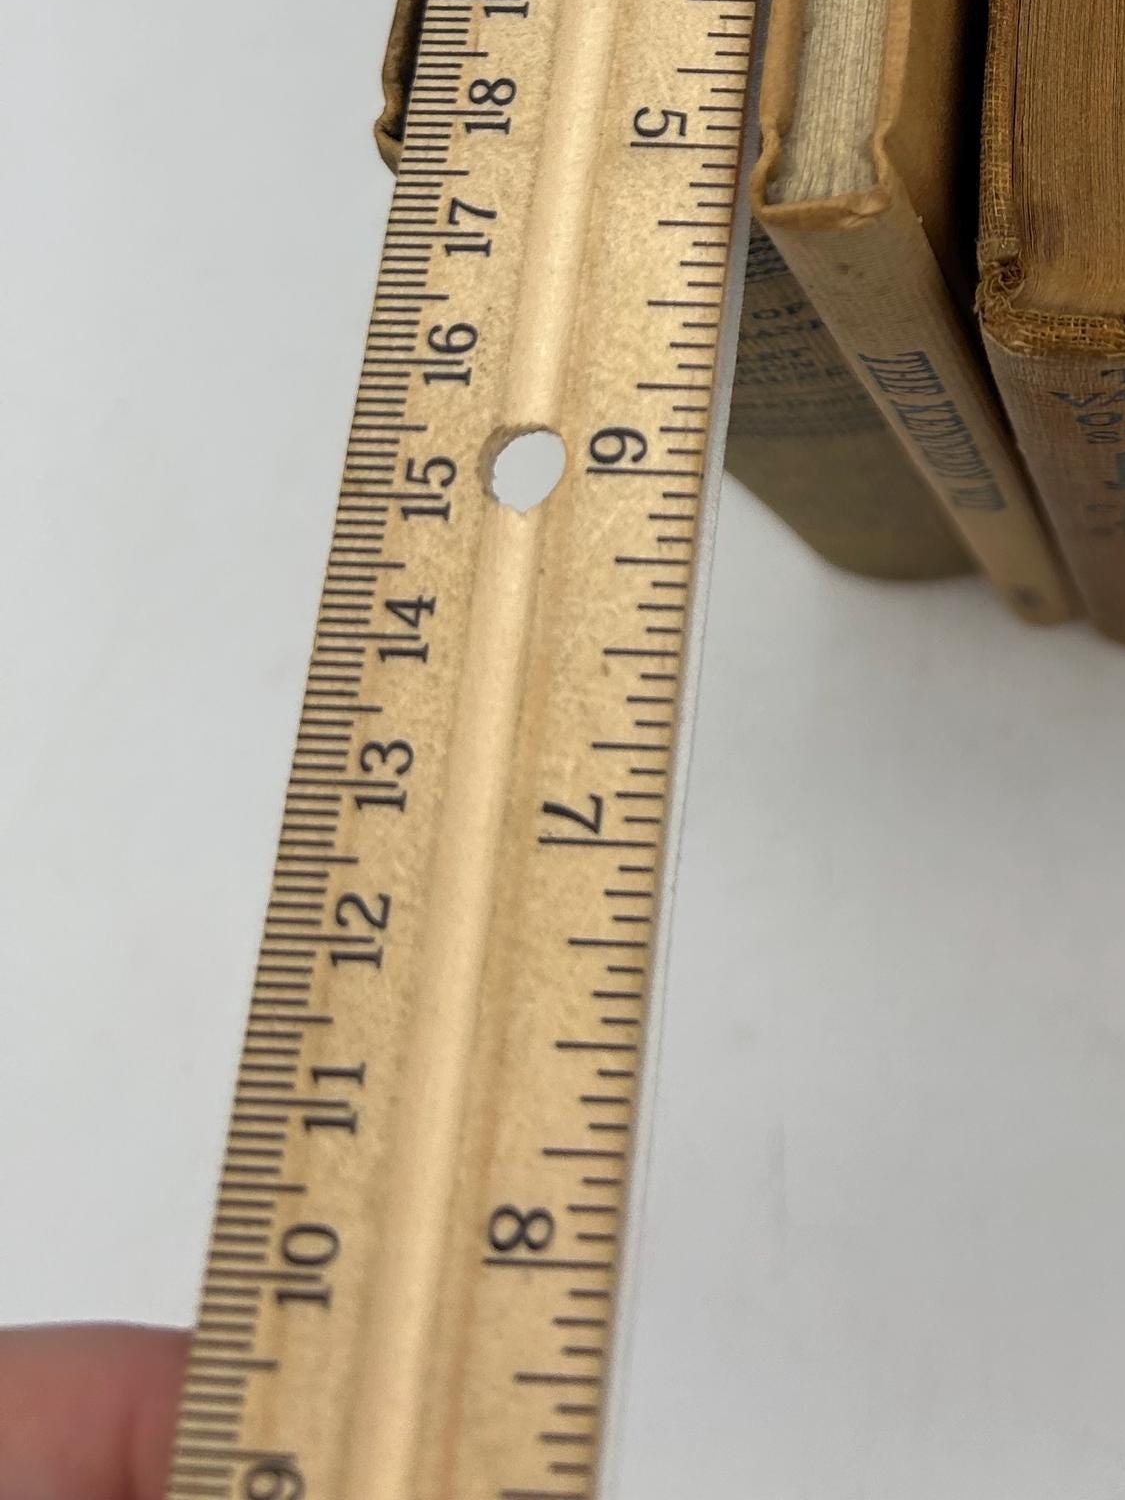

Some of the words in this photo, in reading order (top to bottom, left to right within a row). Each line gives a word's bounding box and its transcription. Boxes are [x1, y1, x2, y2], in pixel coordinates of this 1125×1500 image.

[464, 77, 518, 136] 18
[632, 107, 688, 138] 5
[444, 197, 498, 259] 17
[423, 322, 479, 386] 16
[857, 350, 946, 396] THE
[589, 426, 648, 465] 6
[400, 455, 458, 523] 15
[377, 594, 438, 664] 14
[354, 738, 415, 813] 13
[542, 793, 605, 835] 7
[330, 892, 391, 970] 12
[303, 1062, 367, 1136] 11
[486, 1204, 557, 1253] 8
[274, 1221, 341, 1311] 10
